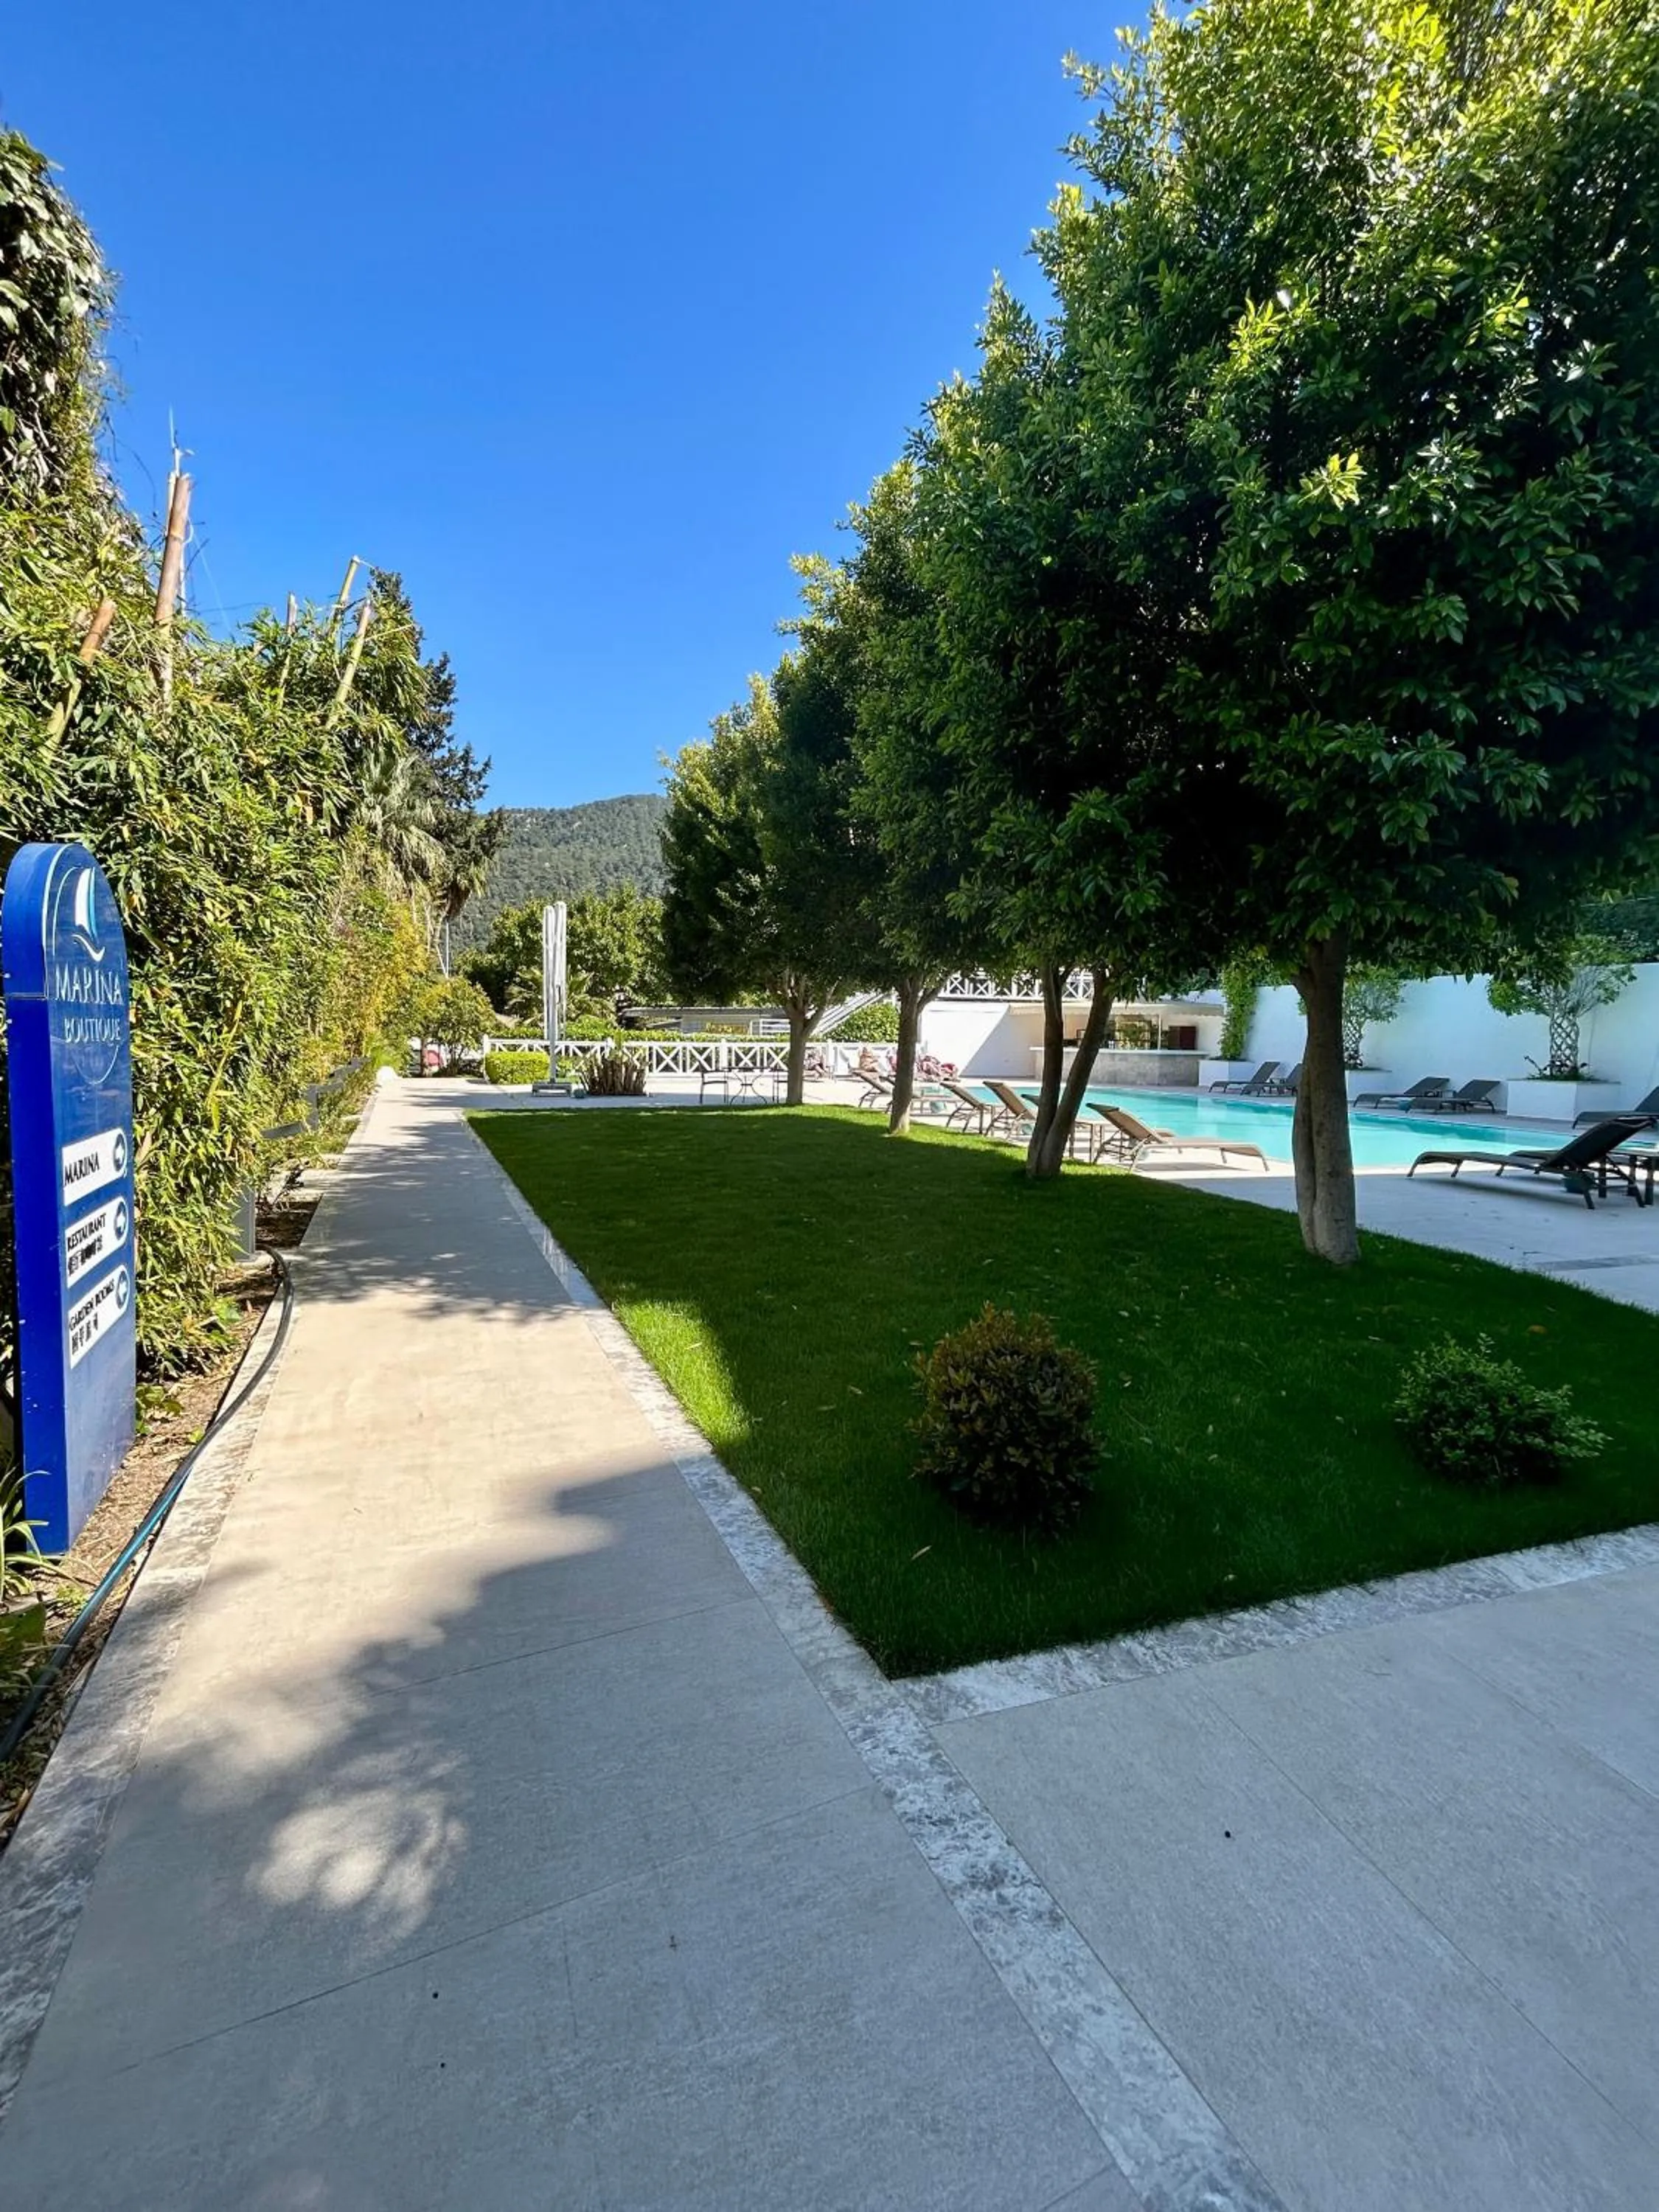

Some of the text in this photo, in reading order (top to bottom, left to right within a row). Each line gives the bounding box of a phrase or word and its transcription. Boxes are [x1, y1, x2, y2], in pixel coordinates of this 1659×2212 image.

[55, 962, 124, 1005] MARINA
[64, 1018, 121, 1046] BOUTIQUE
[64, 1151, 100, 1186] MARINA
